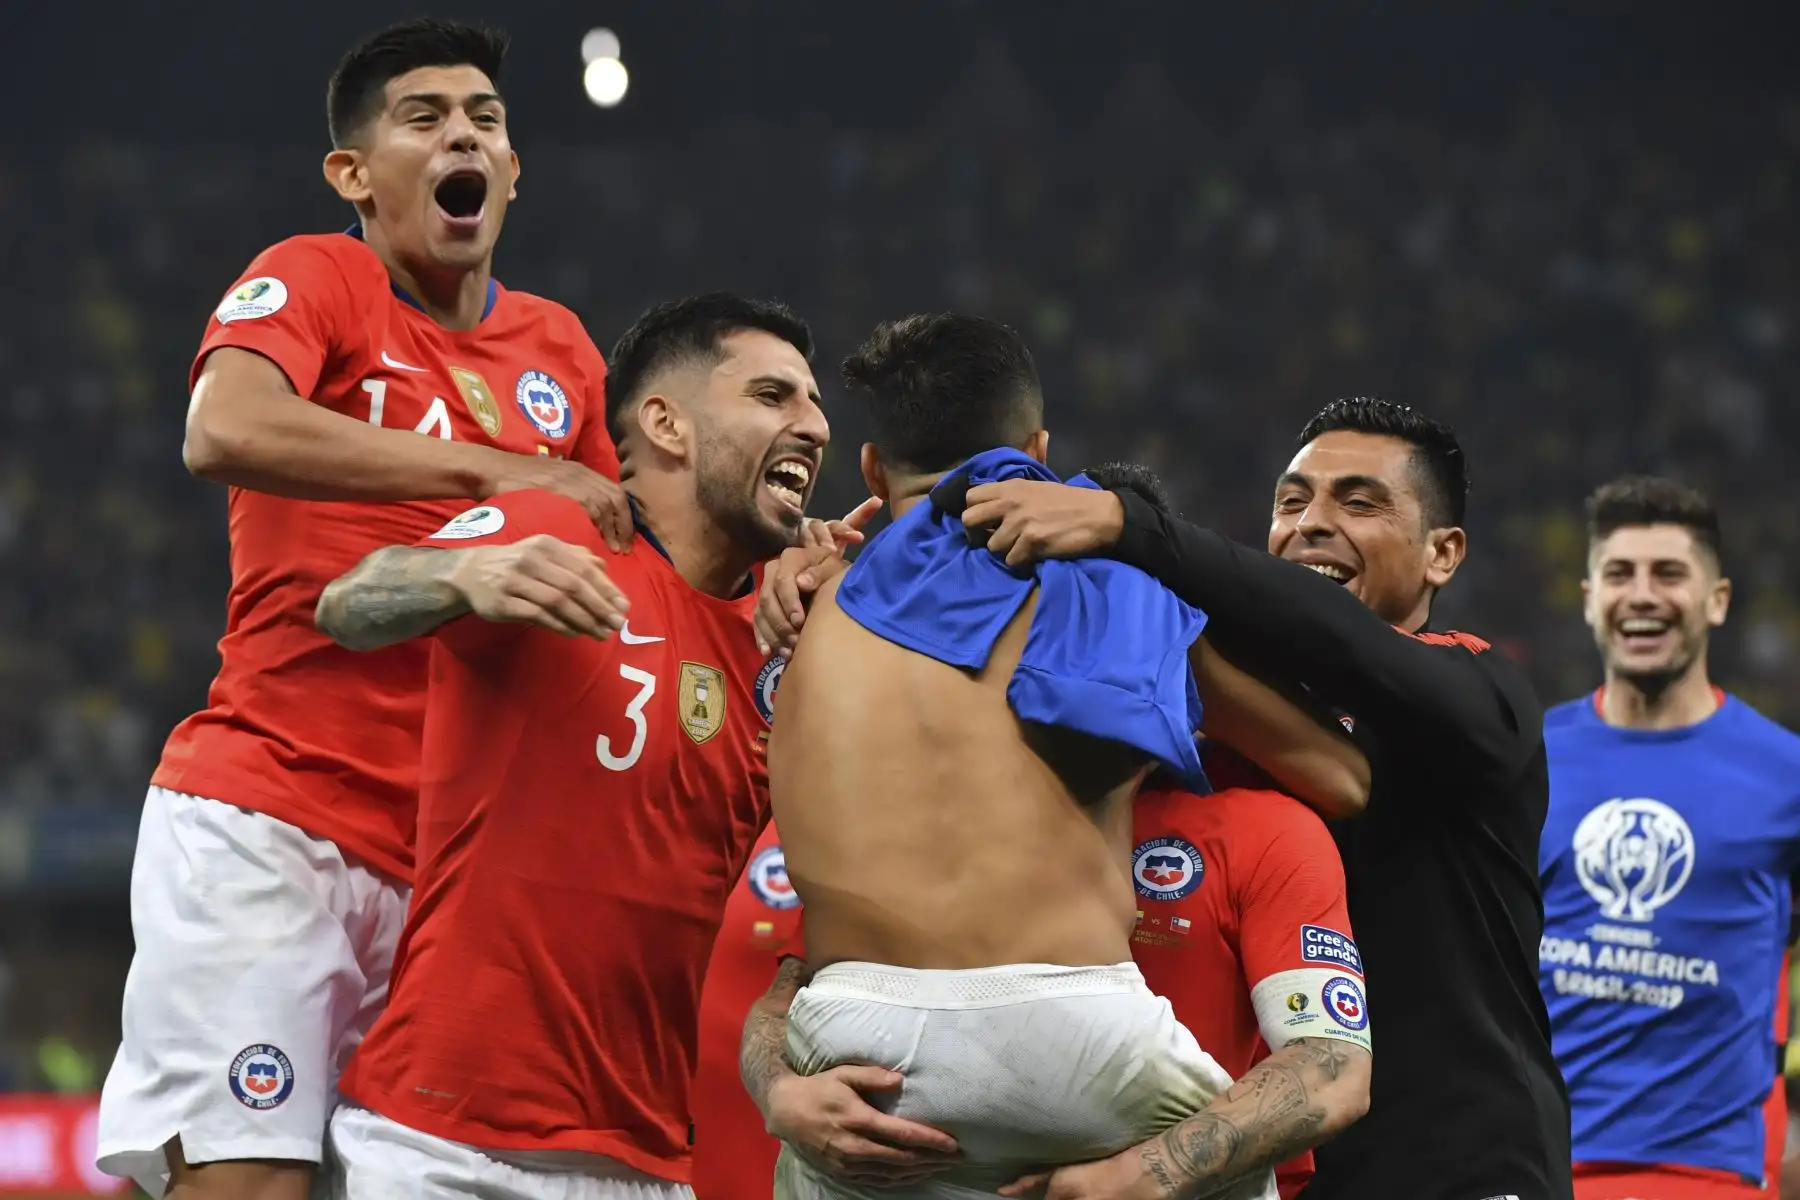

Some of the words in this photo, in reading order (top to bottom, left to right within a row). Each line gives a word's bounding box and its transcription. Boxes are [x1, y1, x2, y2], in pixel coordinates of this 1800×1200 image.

[596, 663, 656, 772] 3
[1173, 839, 1186, 849] DE
[1186, 846, 1204, 873] FUTBOL
[1156, 891, 1182, 901] CHILE
[1306, 929, 1341, 947] Cree
[1343, 942, 1358, 956] en
[1306, 944, 1358, 966] grande
[1595, 945, 1719, 987] AMERICA
